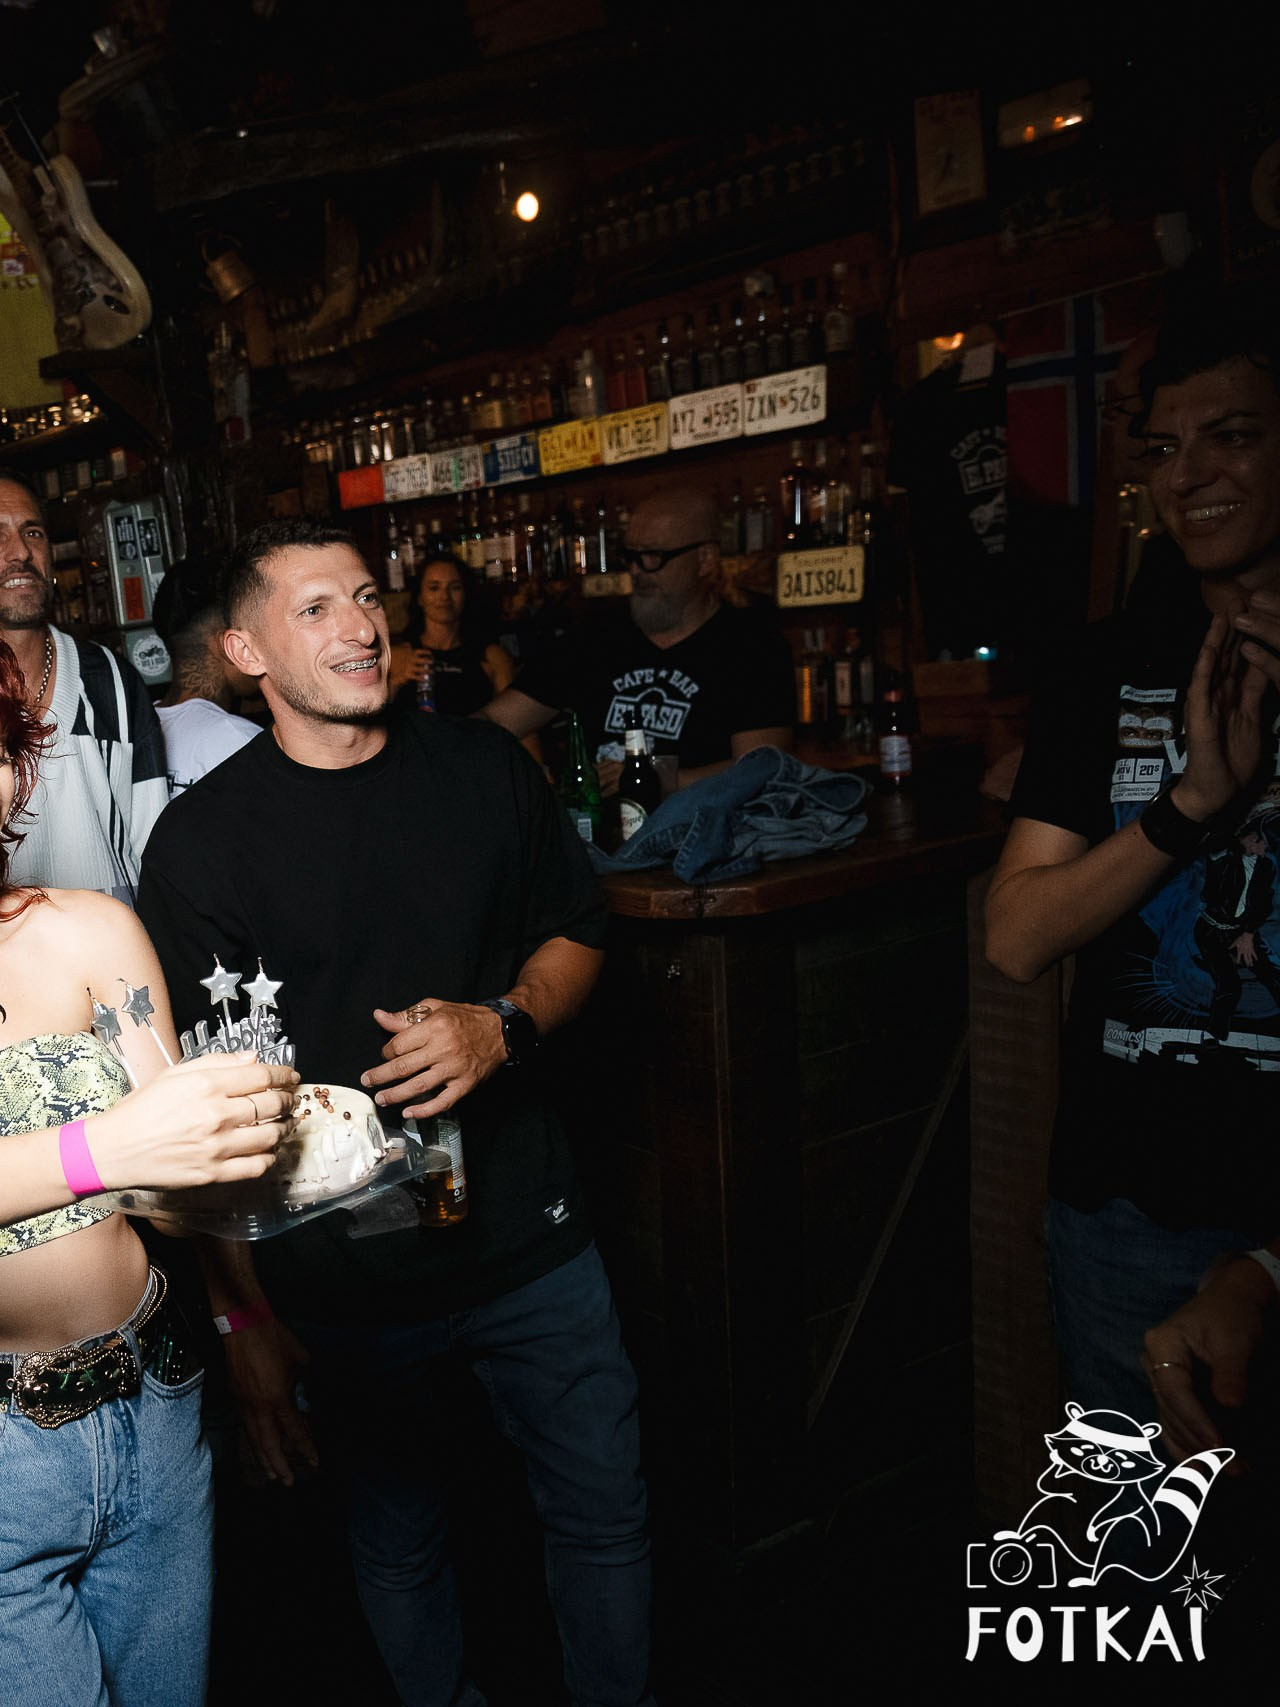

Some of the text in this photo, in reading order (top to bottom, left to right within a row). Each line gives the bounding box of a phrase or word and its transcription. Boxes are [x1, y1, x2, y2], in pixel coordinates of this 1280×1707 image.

[713, 398, 740, 428] 595
[745, 392, 778, 422] ZXN
[788, 386, 821, 415] 526
[783, 567, 857, 598] 3AIS841
[612, 667, 700, 699] CAFE BAR
[1105, 1027, 1143, 1044] COMICS
